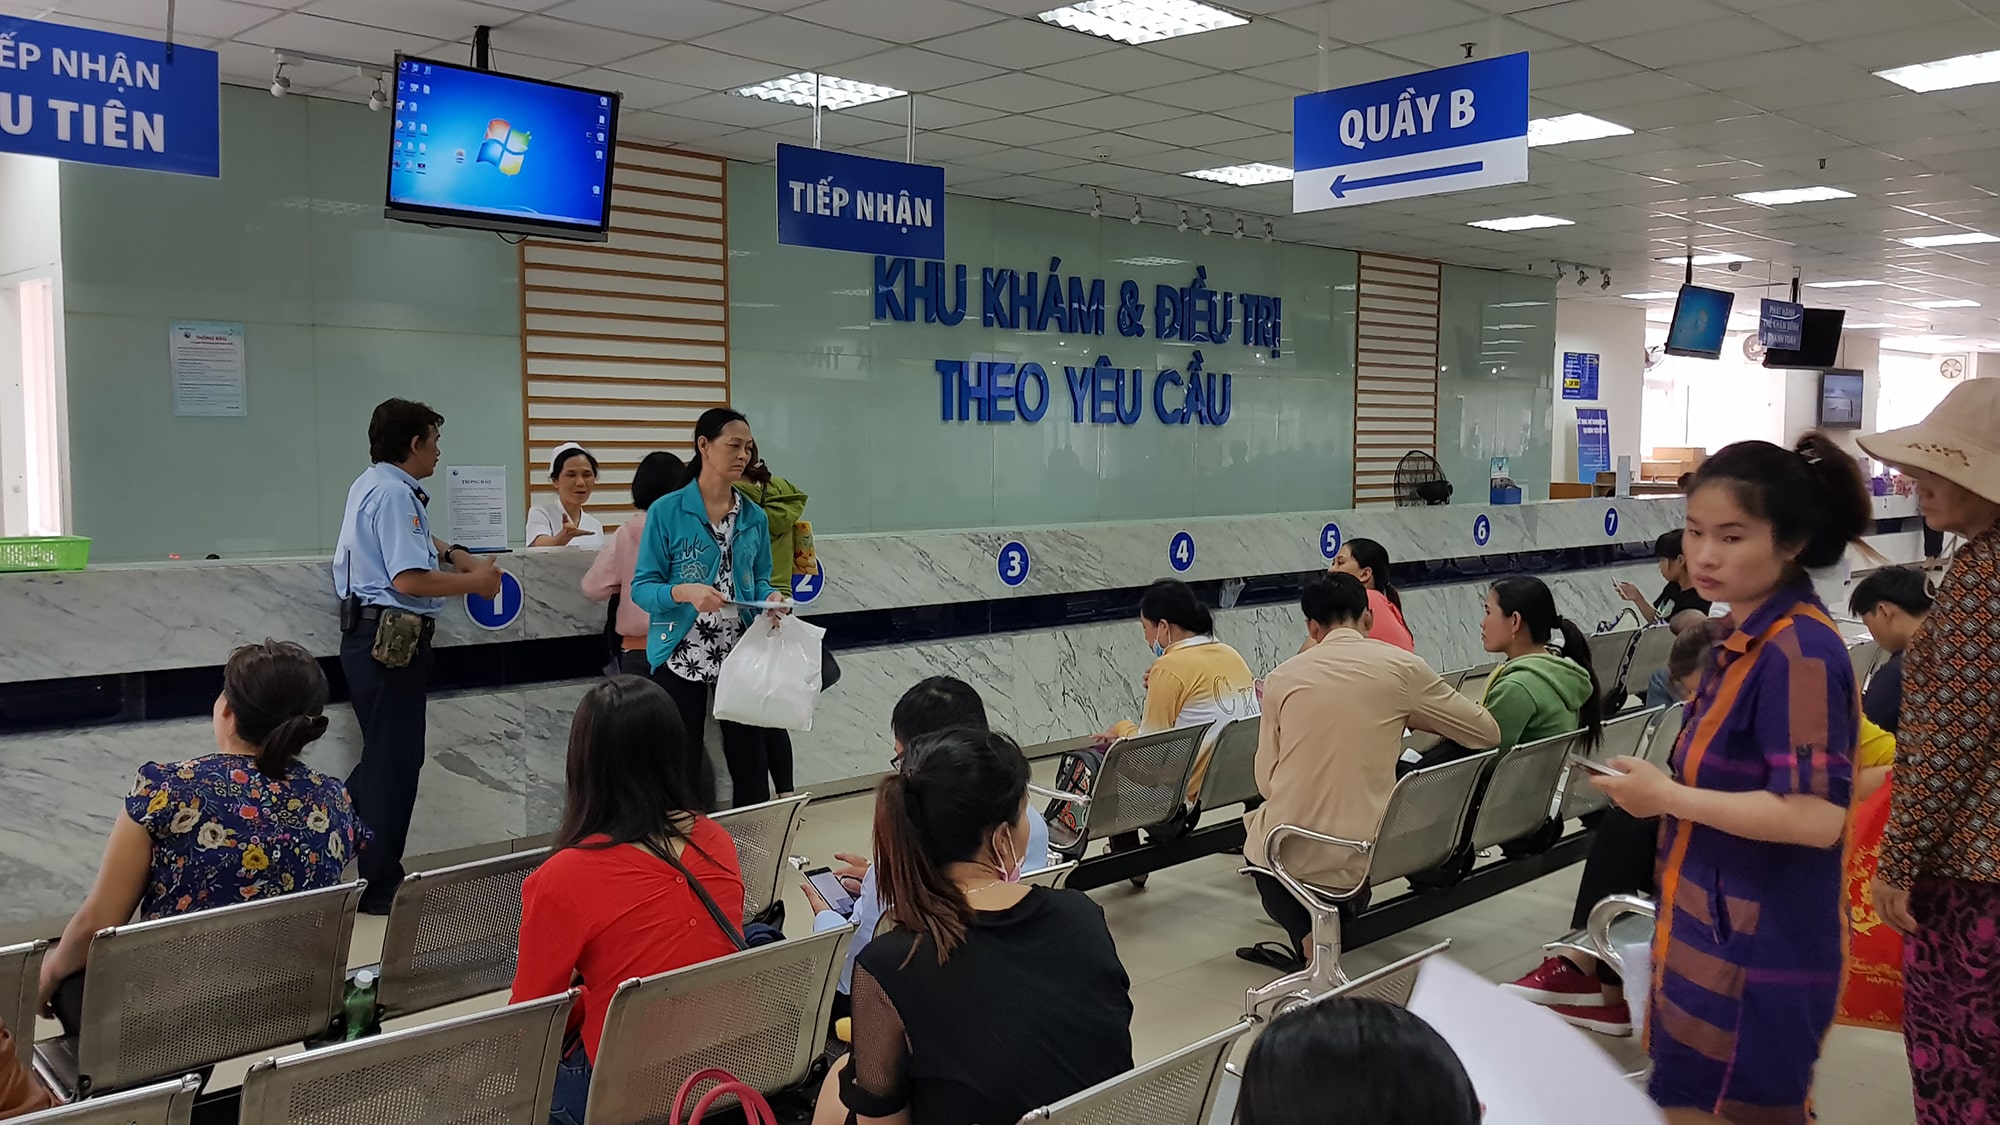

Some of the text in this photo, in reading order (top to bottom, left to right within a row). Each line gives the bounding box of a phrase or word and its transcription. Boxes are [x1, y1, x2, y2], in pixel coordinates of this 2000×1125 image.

[52, 47, 160, 93] NHẬN
[48, 99, 165, 154] TIÊN
[1339, 87, 1476, 150] QUẦY B
[788, 175, 933, 234] TIẾP NHẬN
[874, 255, 1282, 359] KHU KHÁM & ĐIỀU TRỊ
[935, 350, 1232, 426] THEO YÊU CẦU
[1326, 530, 1336, 552] 5
[1478, 520, 1487, 540] 6
[1608, 513, 1616, 531] 7
[1006, 550, 1022, 578] 3
[1175, 539, 1190, 564] 4
